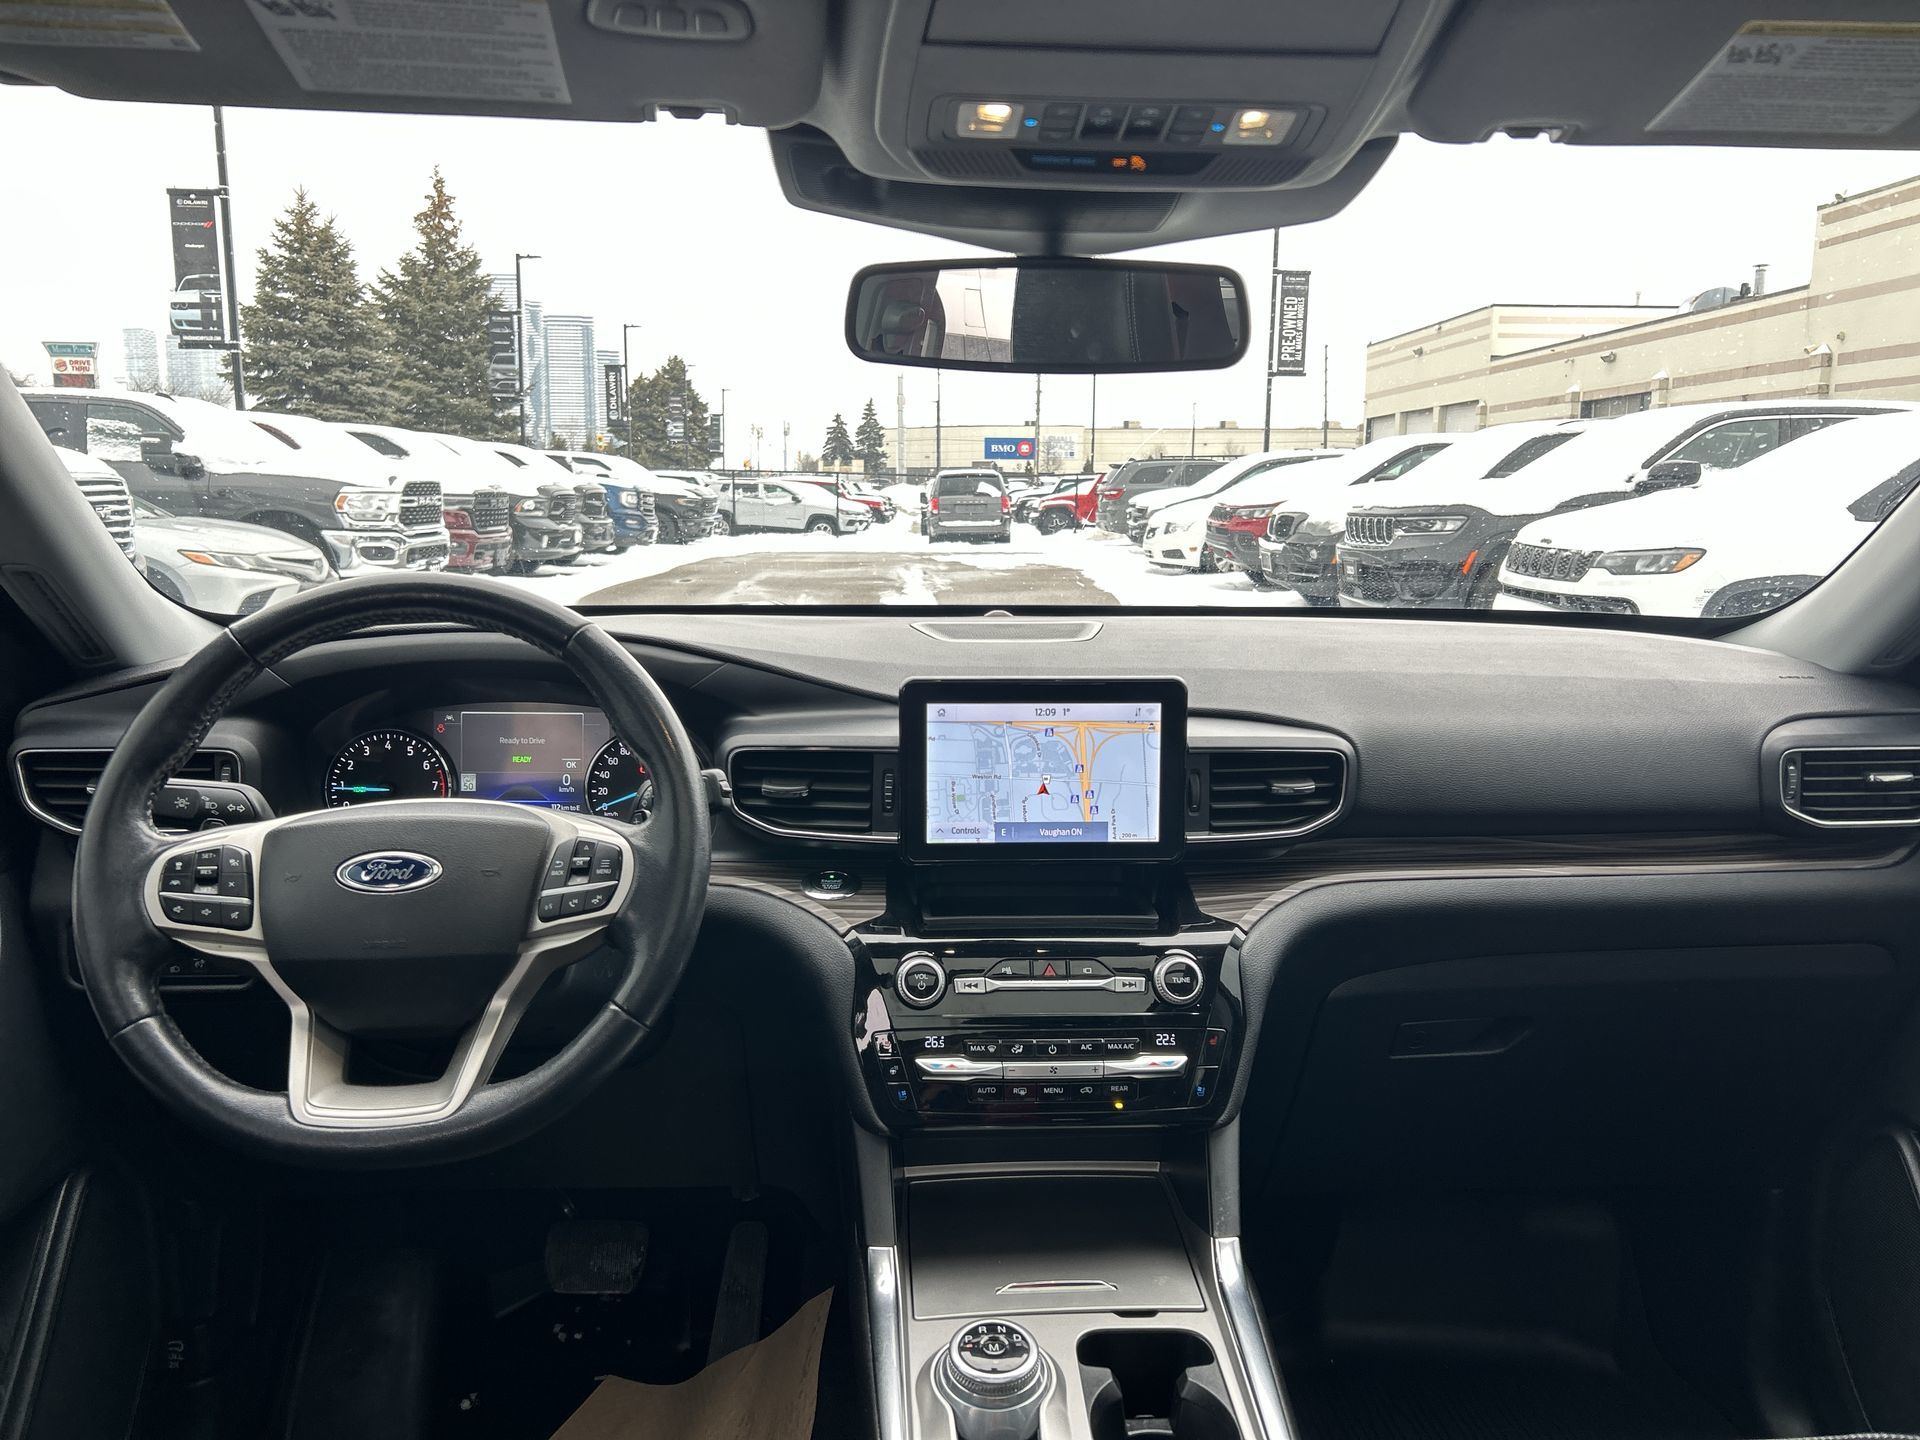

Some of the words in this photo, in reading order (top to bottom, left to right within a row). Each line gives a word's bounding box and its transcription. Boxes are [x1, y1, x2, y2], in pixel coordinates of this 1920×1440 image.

[1297, 297, 1305, 318] MODELS
[1281, 296, 1298, 361] PRE-OWNED
[1296, 319, 1304, 331] AND
[1295, 332, 1304, 350] MAKES
[1294, 350, 1302, 361] ALL
[608, 371, 617, 410] DILAWRI
[991, 444, 1016, 452] BMO
[1034, 708, 1056, 717] 12:09
[385, 740, 392, 750] 4
[499, 737, 520, 745] Ready
[363, 746, 370, 756] 3
[407, 746, 414, 756] 5
[347, 760, 354, 770] 2
[423, 760, 430, 770] 6
[565, 761, 577, 769] OK
[607, 757, 619, 766] 60
[599, 770, 610, 779] 40
[562, 773, 571, 786] 0
[431, 781, 438, 791] 7
[463, 782, 474, 790] 50
[598, 787, 608, 796] 20
[602, 802, 608, 811] 0
[951, 826, 980, 835] Controls
[1039, 828, 1071, 837] Vaughan
[1071, 828, 1083, 836] ON
[360, 858, 416, 881] Ford
[1172, 976, 1190, 984] TUNE
[924, 1036, 945, 1048] 26.5
[1155, 1033, 1176, 1046] 22.5
[978, 1325, 988, 1334] R
[997, 1325, 1007, 1334] N
[964, 1335, 973, 1343] P
[1012, 1333, 1022, 1342] D
[988, 1343, 1000, 1351] M
